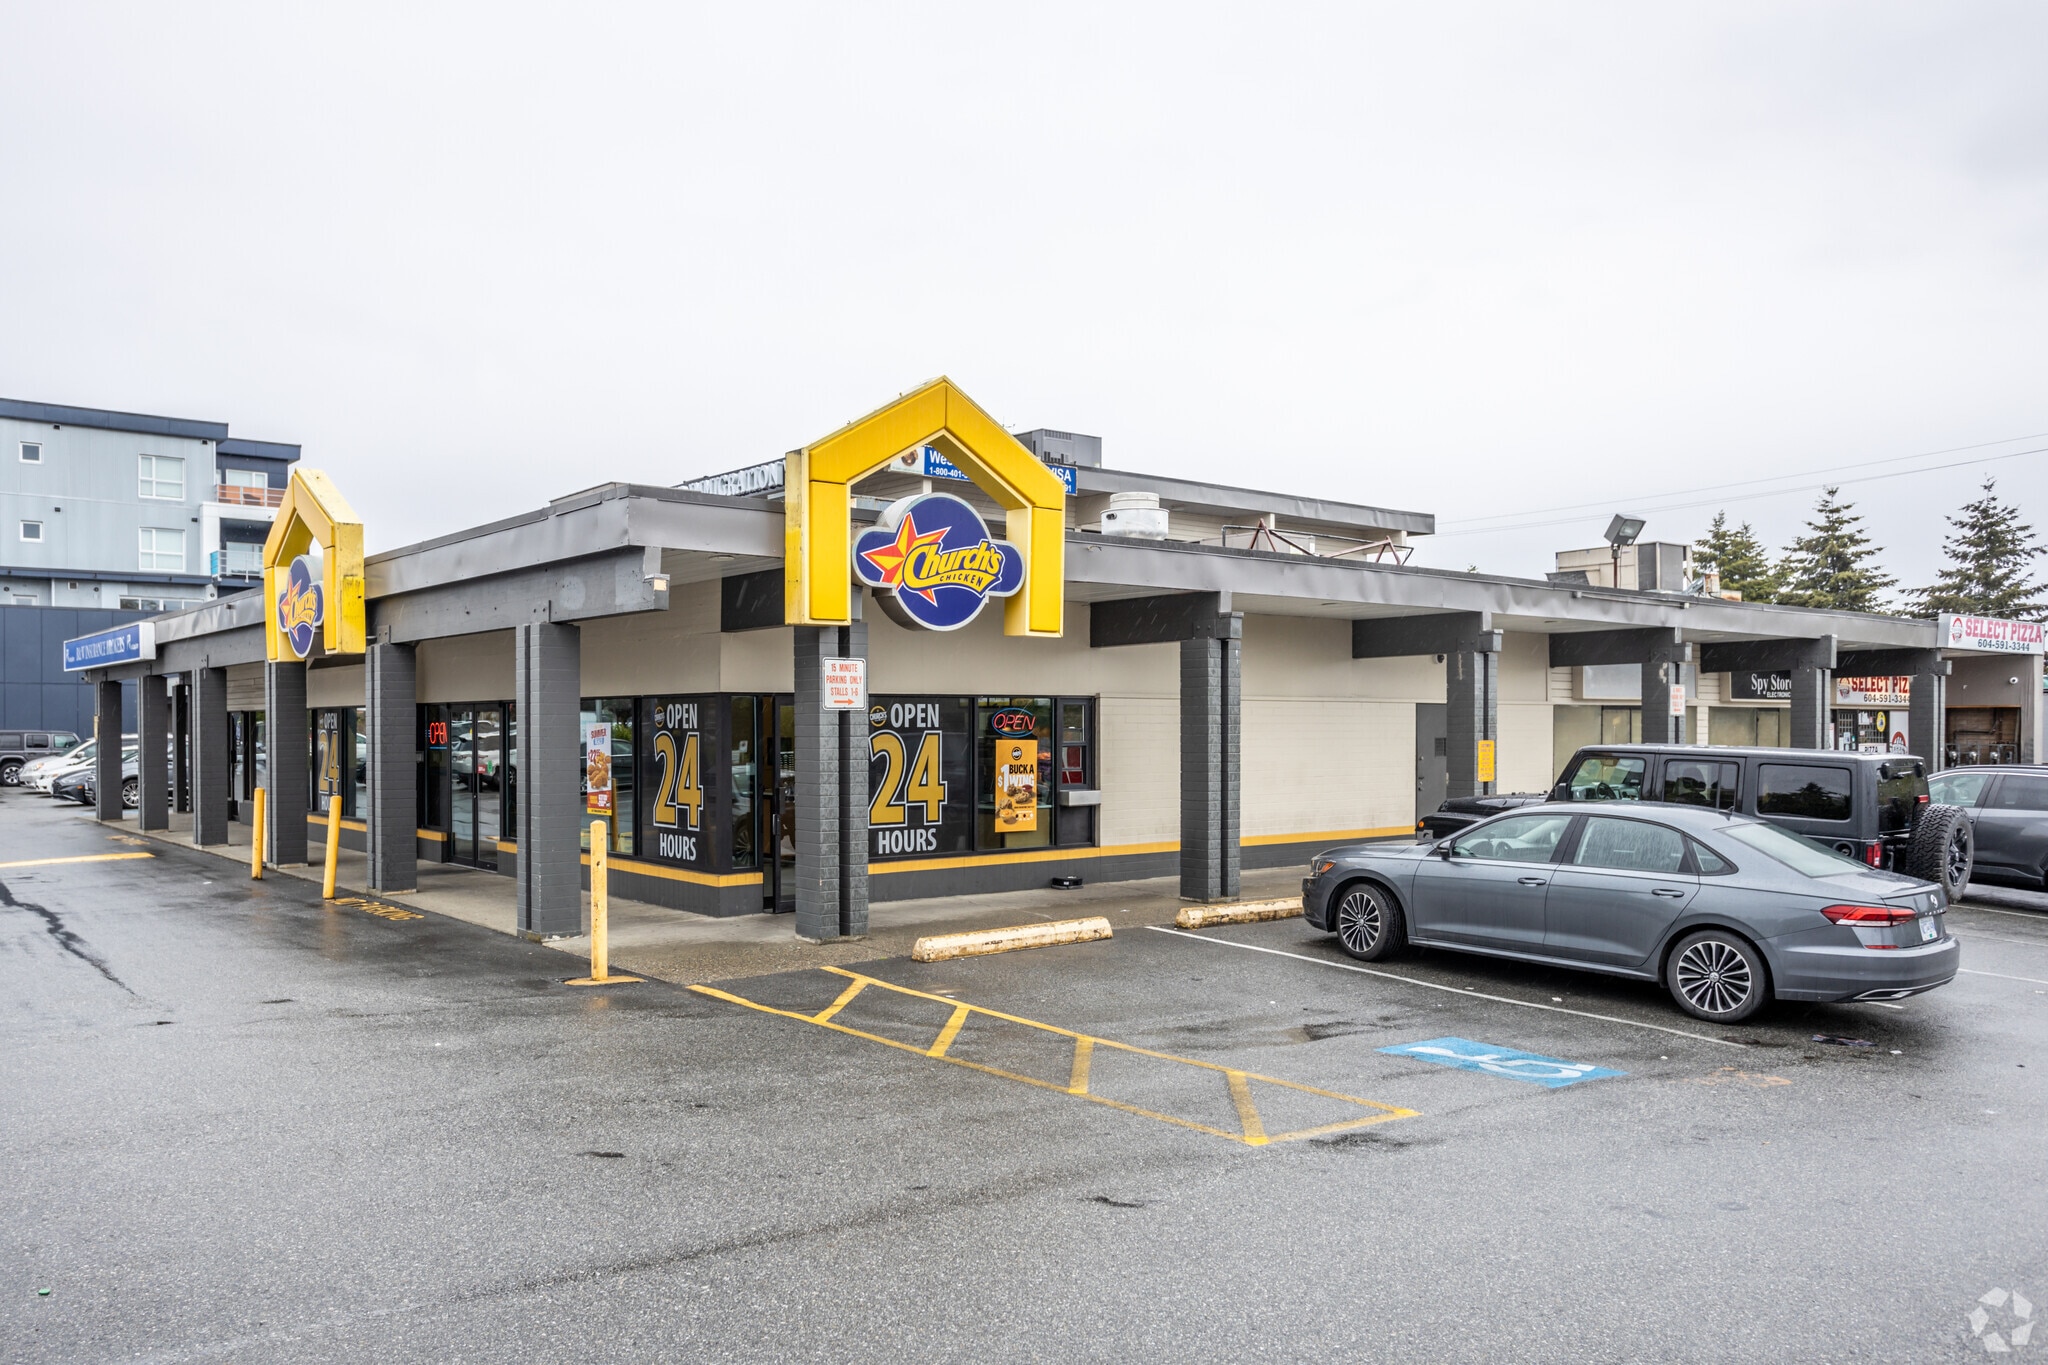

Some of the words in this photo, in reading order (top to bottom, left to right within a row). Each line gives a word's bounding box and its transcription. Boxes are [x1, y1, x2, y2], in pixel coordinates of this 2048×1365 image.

[929, 450, 953, 466] We
[1050, 467, 1072, 482] ISA
[903, 541, 1003, 588] Church's
[940, 573, 983, 588] CHICKEN
[1965, 618, 2008, 641] SELECT
[2010, 623, 2042, 643] PIZZA
[1978, 639, 2030, 651] 604-591-3344
[831, 664, 836, 672] 15
[839, 664, 858, 672] MINUTE
[826, 675, 847, 684] PARKING
[850, 676, 863, 684] ONLY
[1751, 673, 1769, 695] Spy
[1851, 676, 1889, 693] SELECT
[1892, 676, 1910, 693] PIZ
[830, 687, 848, 696] STALLS
[324, 712, 338, 730] OPEN
[667, 703, 698, 729] OPEN
[890, 703, 940, 728] OPEN
[994, 713, 1036, 730] OPEN
[319, 730, 339, 795] 24
[1009, 764, 1028, 775] BUCK
[1029, 764, 1035, 775] A
[653, 730, 704, 831] 24
[868, 729, 948, 829] 24
[997, 763, 1010, 793] $1
[1009, 774, 1035, 788] WING
[660, 832, 697, 861] HOURS
[878, 828, 937, 855] HOURS
